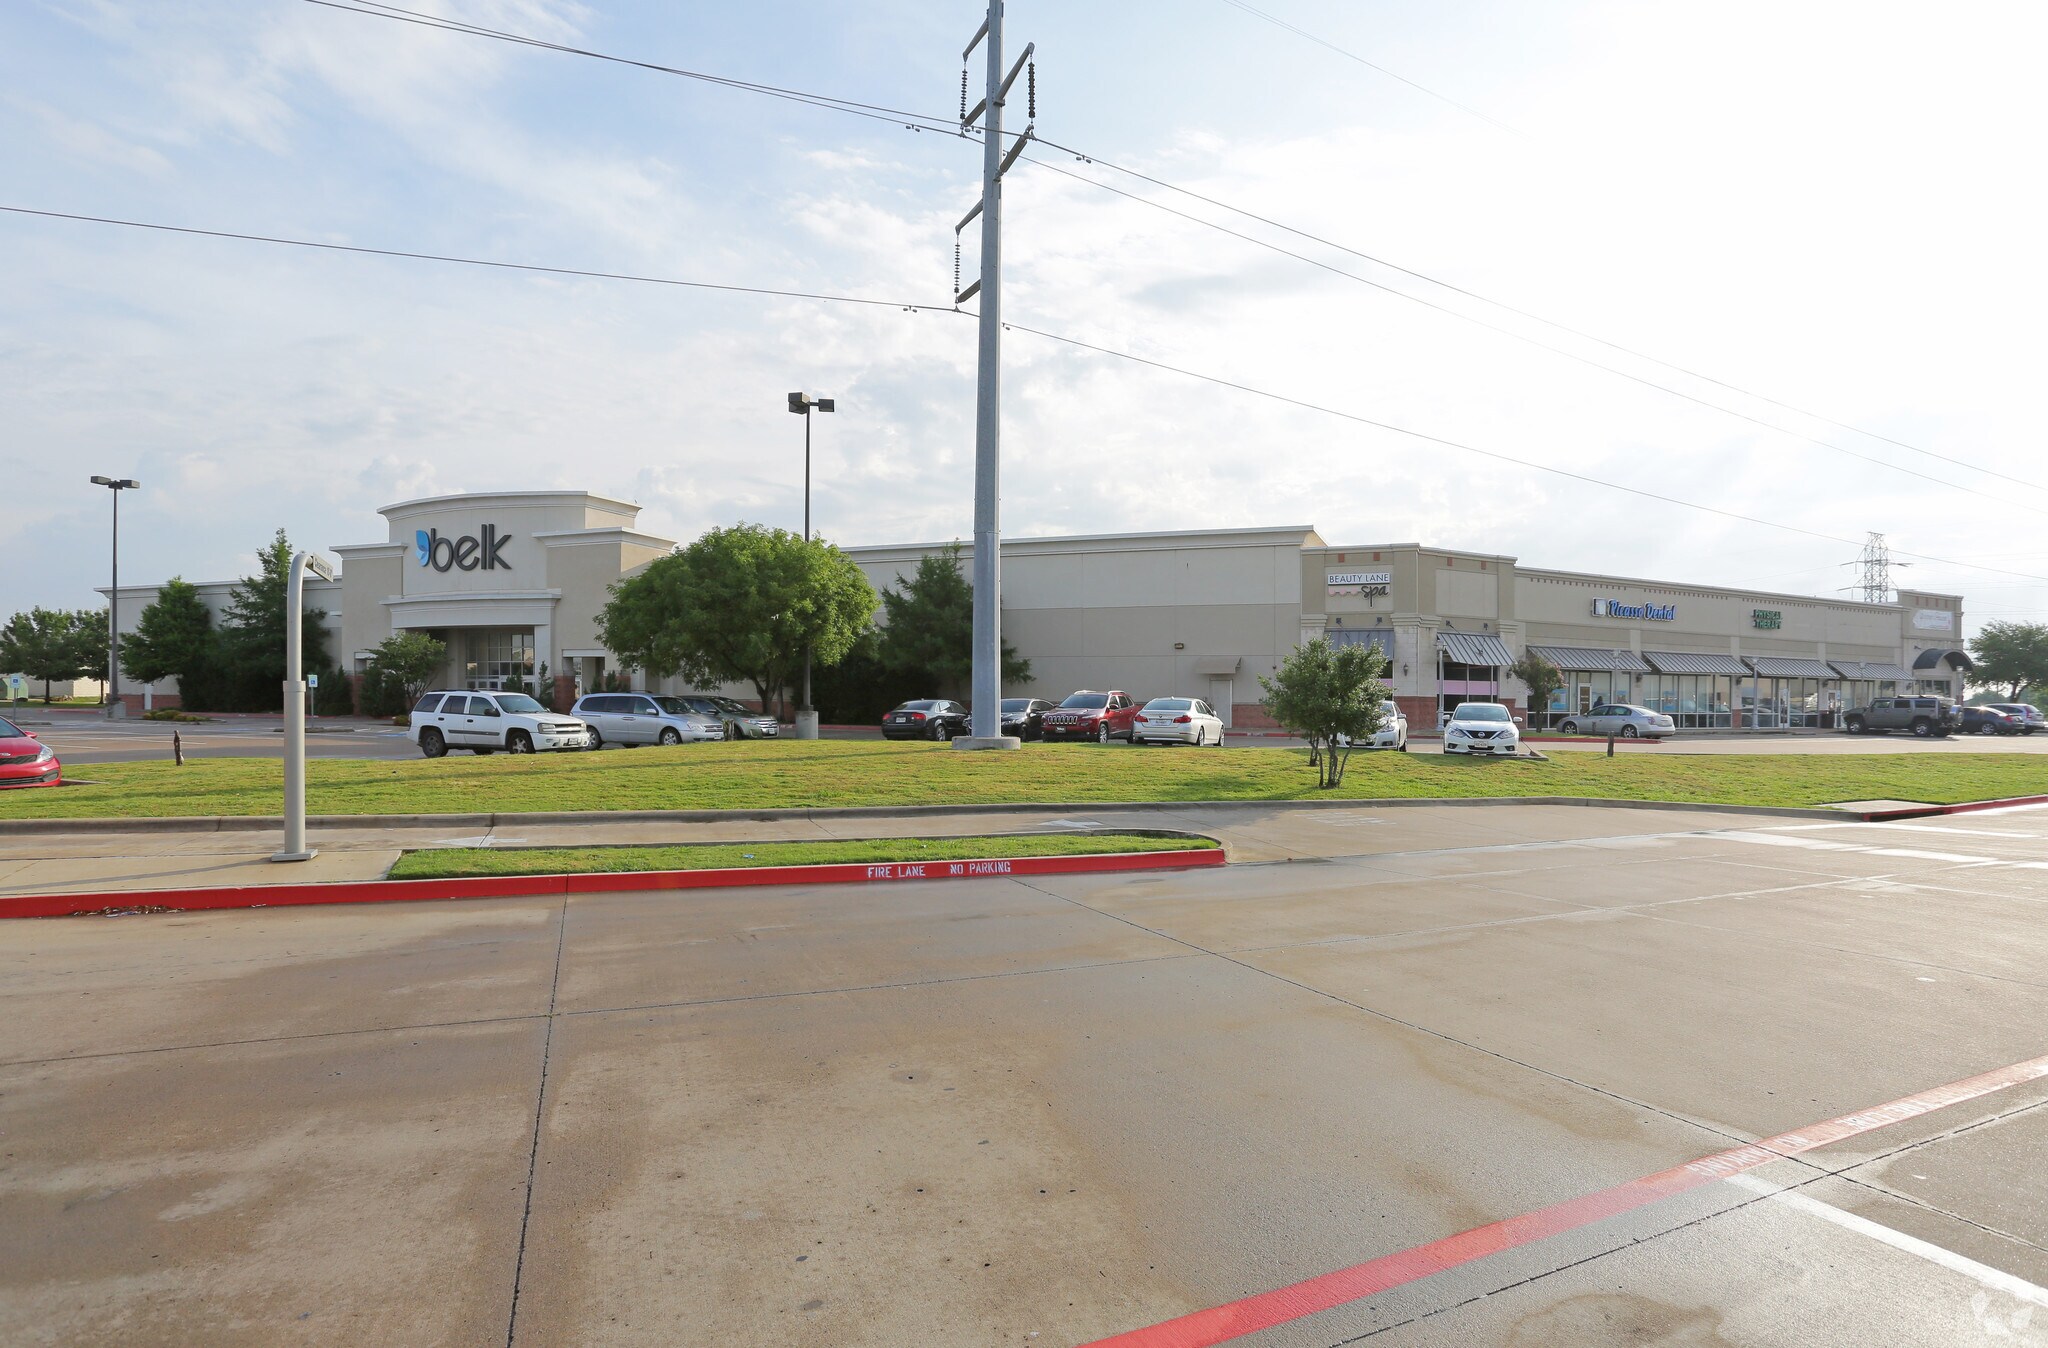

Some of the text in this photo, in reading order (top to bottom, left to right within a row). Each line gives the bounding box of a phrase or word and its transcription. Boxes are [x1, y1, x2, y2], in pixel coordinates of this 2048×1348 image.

[430, 523, 513, 573] belk
[1329, 573, 1389, 583] BEAUTY LANE
[1360, 585, 1389, 607] spa
[1608, 599, 1676, 621] Picasso Dental
[1754, 609, 1782, 620] PHYSICAL
[1754, 619, 1781, 630] THERAPY
[867, 861, 1011, 878] FIRE LANE NO PARKING
